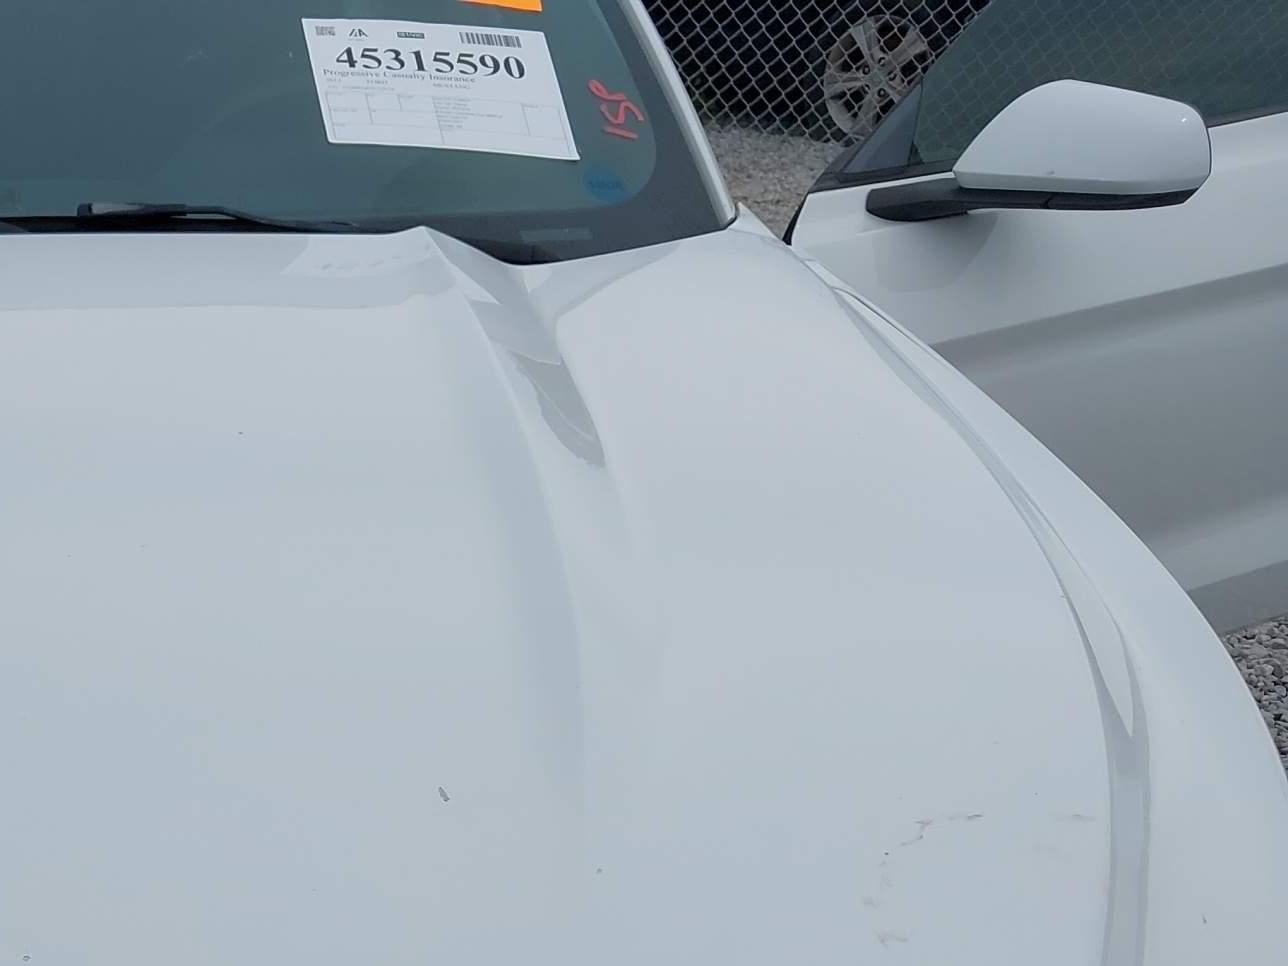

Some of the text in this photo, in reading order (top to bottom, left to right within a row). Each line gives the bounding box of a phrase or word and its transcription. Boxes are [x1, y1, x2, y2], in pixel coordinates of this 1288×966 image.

[335, 46, 525, 79] 45315590
[323, 69, 476, 83] Progressive Casualty Insurance
